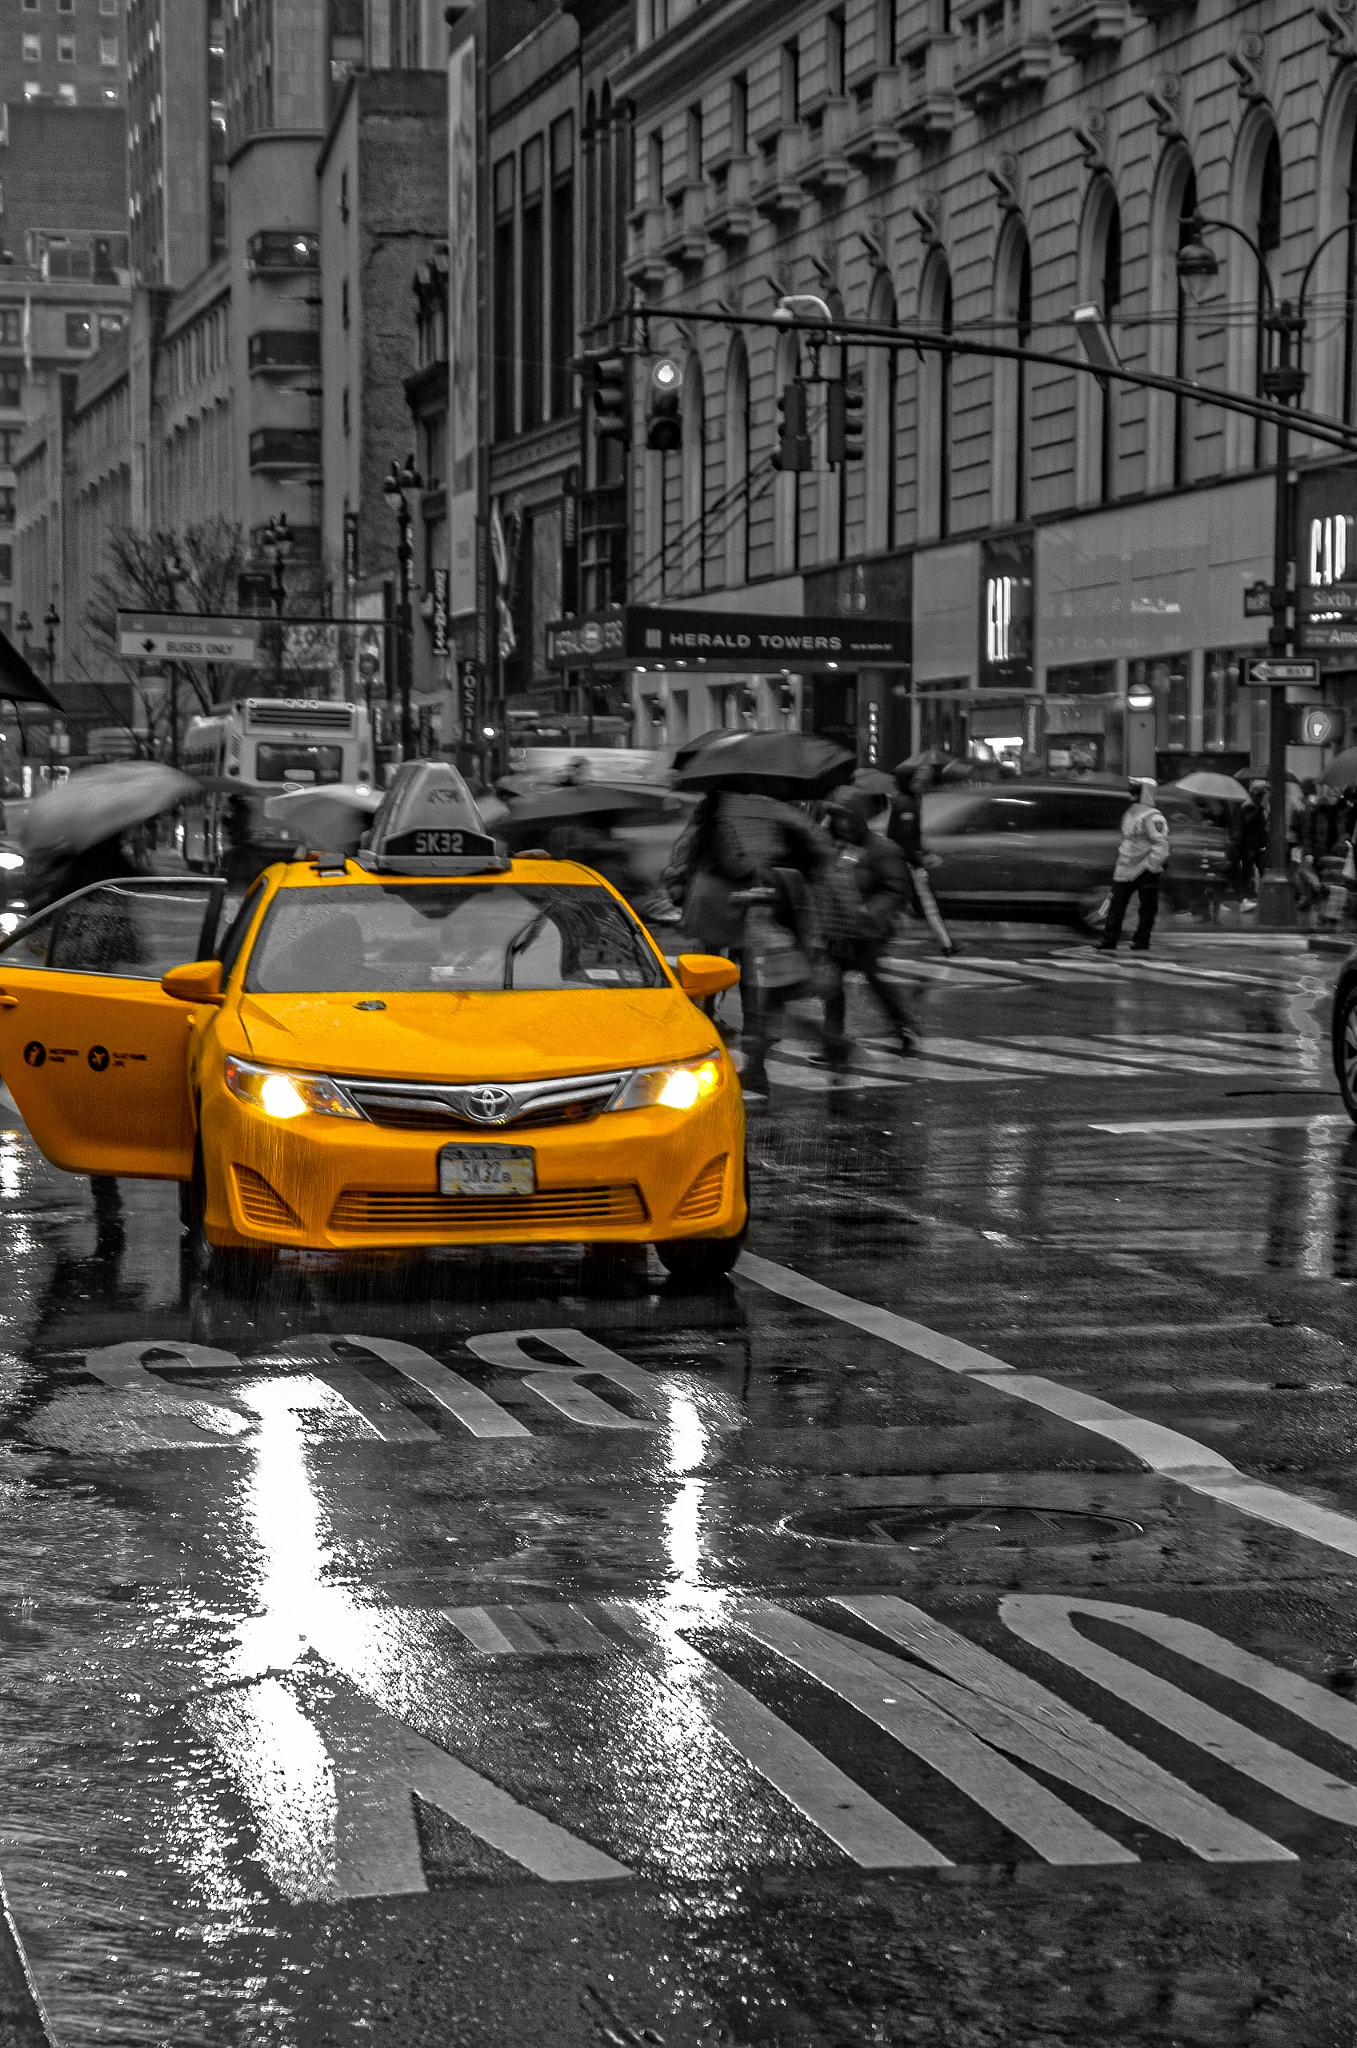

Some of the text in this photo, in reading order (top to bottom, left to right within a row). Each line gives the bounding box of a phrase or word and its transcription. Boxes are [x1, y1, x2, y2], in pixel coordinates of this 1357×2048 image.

[1312, 590, 1351, 608] Sixth
[166, 641, 234, 655] BUSES ONLY
[669, 632, 751, 648] HERALD
[758, 635, 842, 650] TOWERS
[463, 661, 476, 744] FOSSIL
